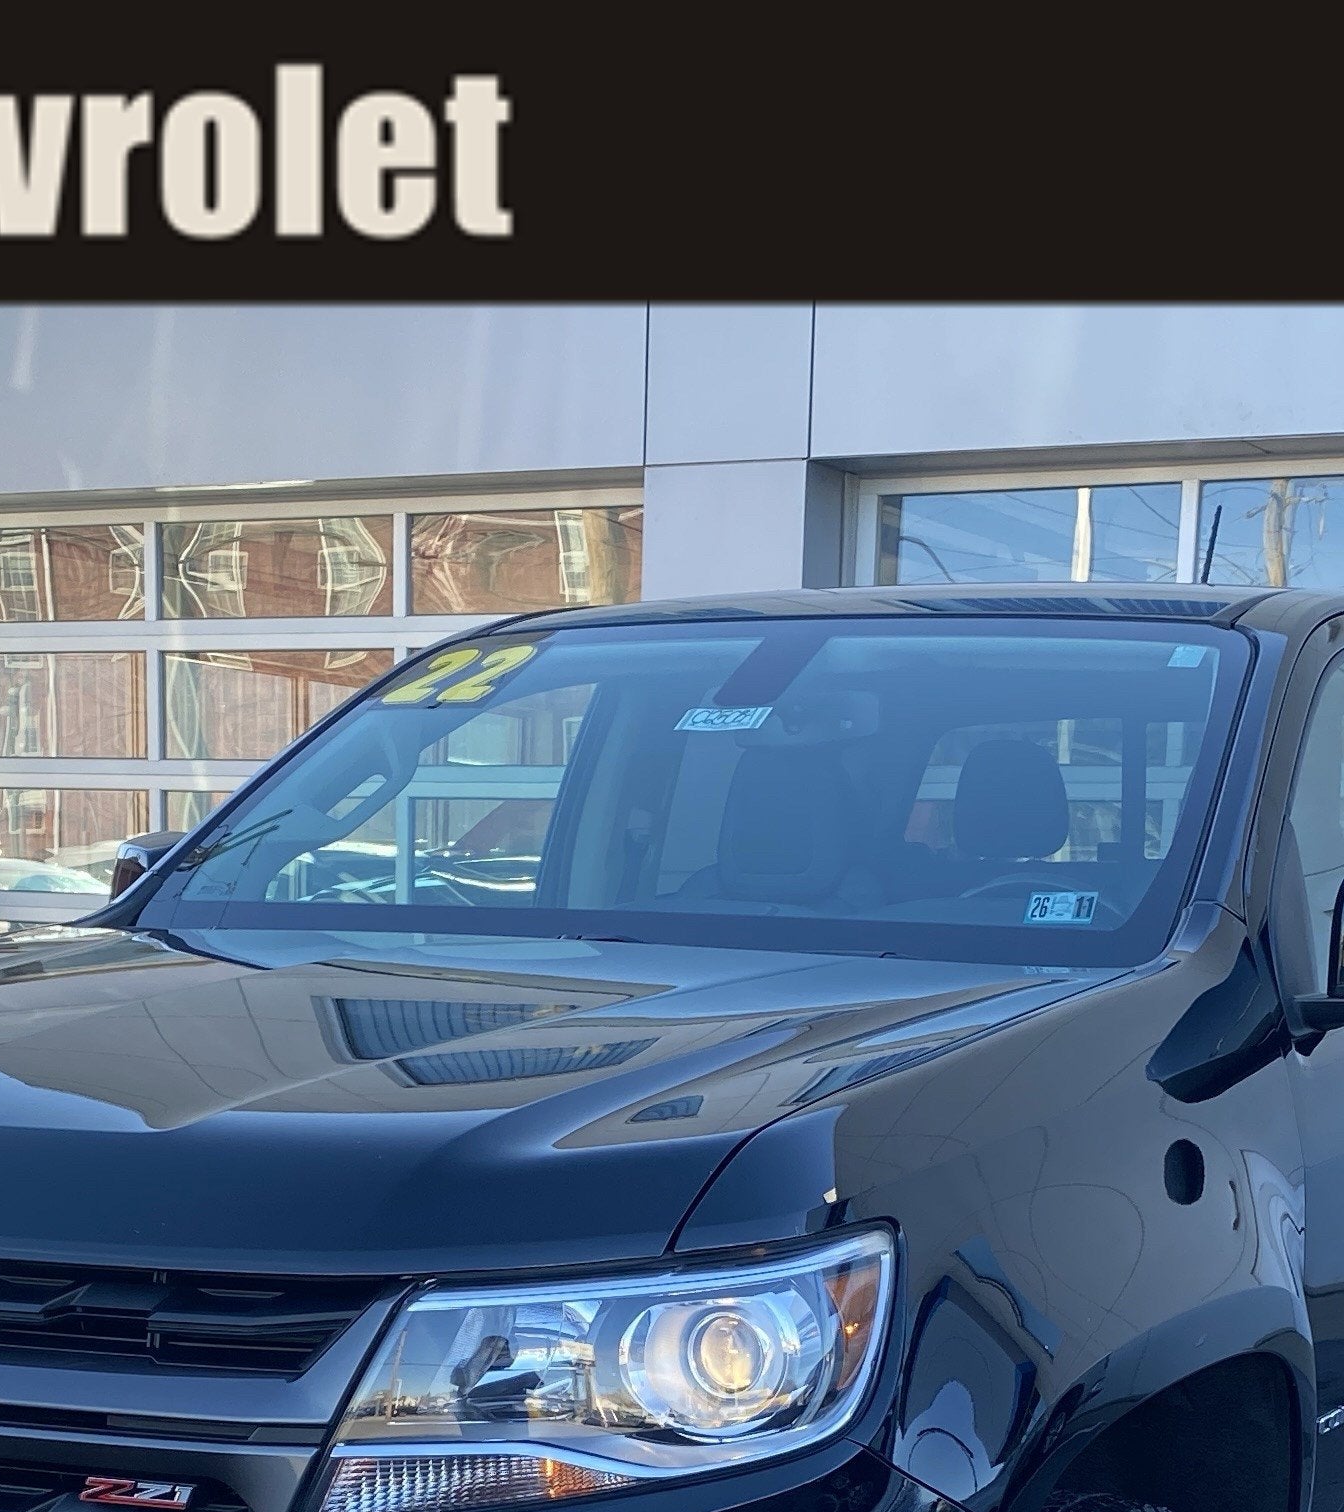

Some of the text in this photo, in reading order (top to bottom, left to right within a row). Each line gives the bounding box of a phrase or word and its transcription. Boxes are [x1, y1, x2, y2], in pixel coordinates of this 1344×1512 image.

[381, 645, 537, 705] 22
[1031, 896, 1050, 918] 26
[1076, 896, 1095, 918] 11
[78, 1476, 193, 1510] Z71
